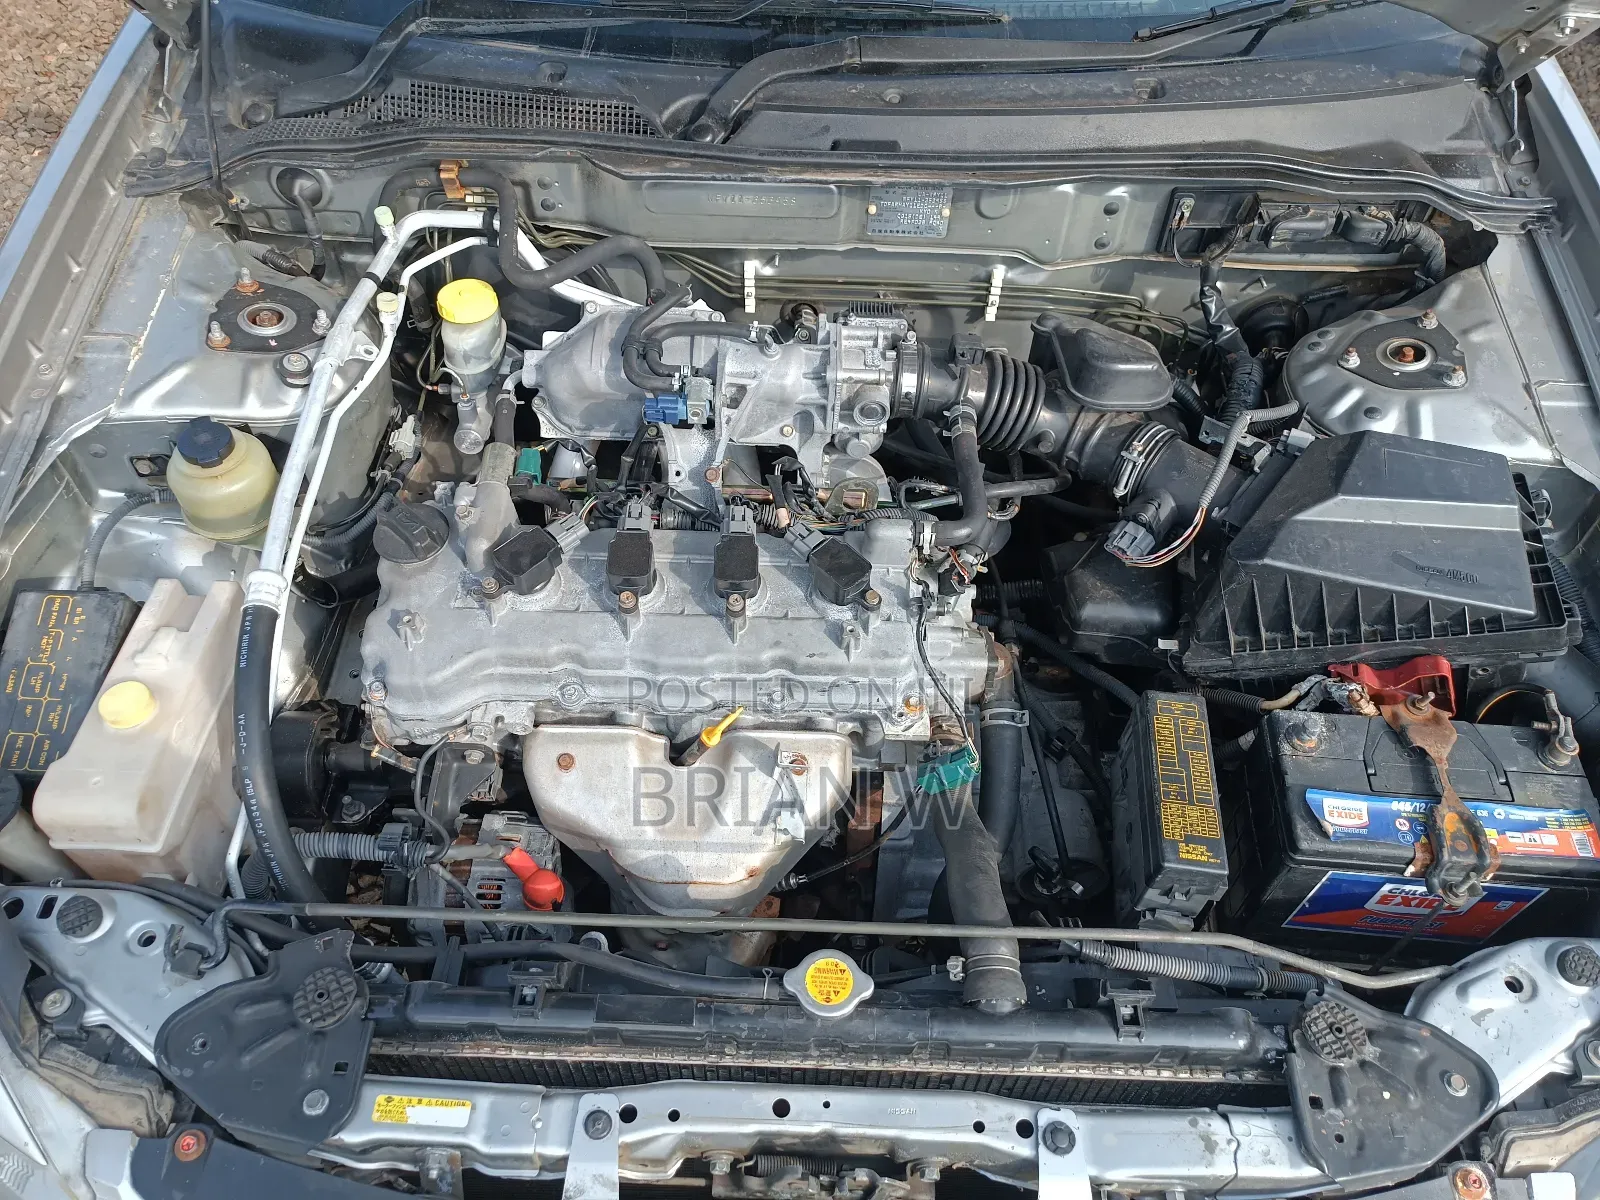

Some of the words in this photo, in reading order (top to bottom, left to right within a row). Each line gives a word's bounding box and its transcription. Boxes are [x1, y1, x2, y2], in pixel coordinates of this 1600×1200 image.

[244, 613, 254, 631] JPN
[239, 633, 250, 668] NICHIRIN
[30, 676, 38, 686] LH
[48, 711, 56, 723] RH
[42, 739, 51, 751] AIR
[38, 751, 47, 767] CON
[1327, 804, 1363, 813] CHLORIDE
[1328, 810, 1364, 821] EXIDE
[1179, 852, 1208, 862] NISSAN
[435, 1099, 467, 1107] CAUTION
